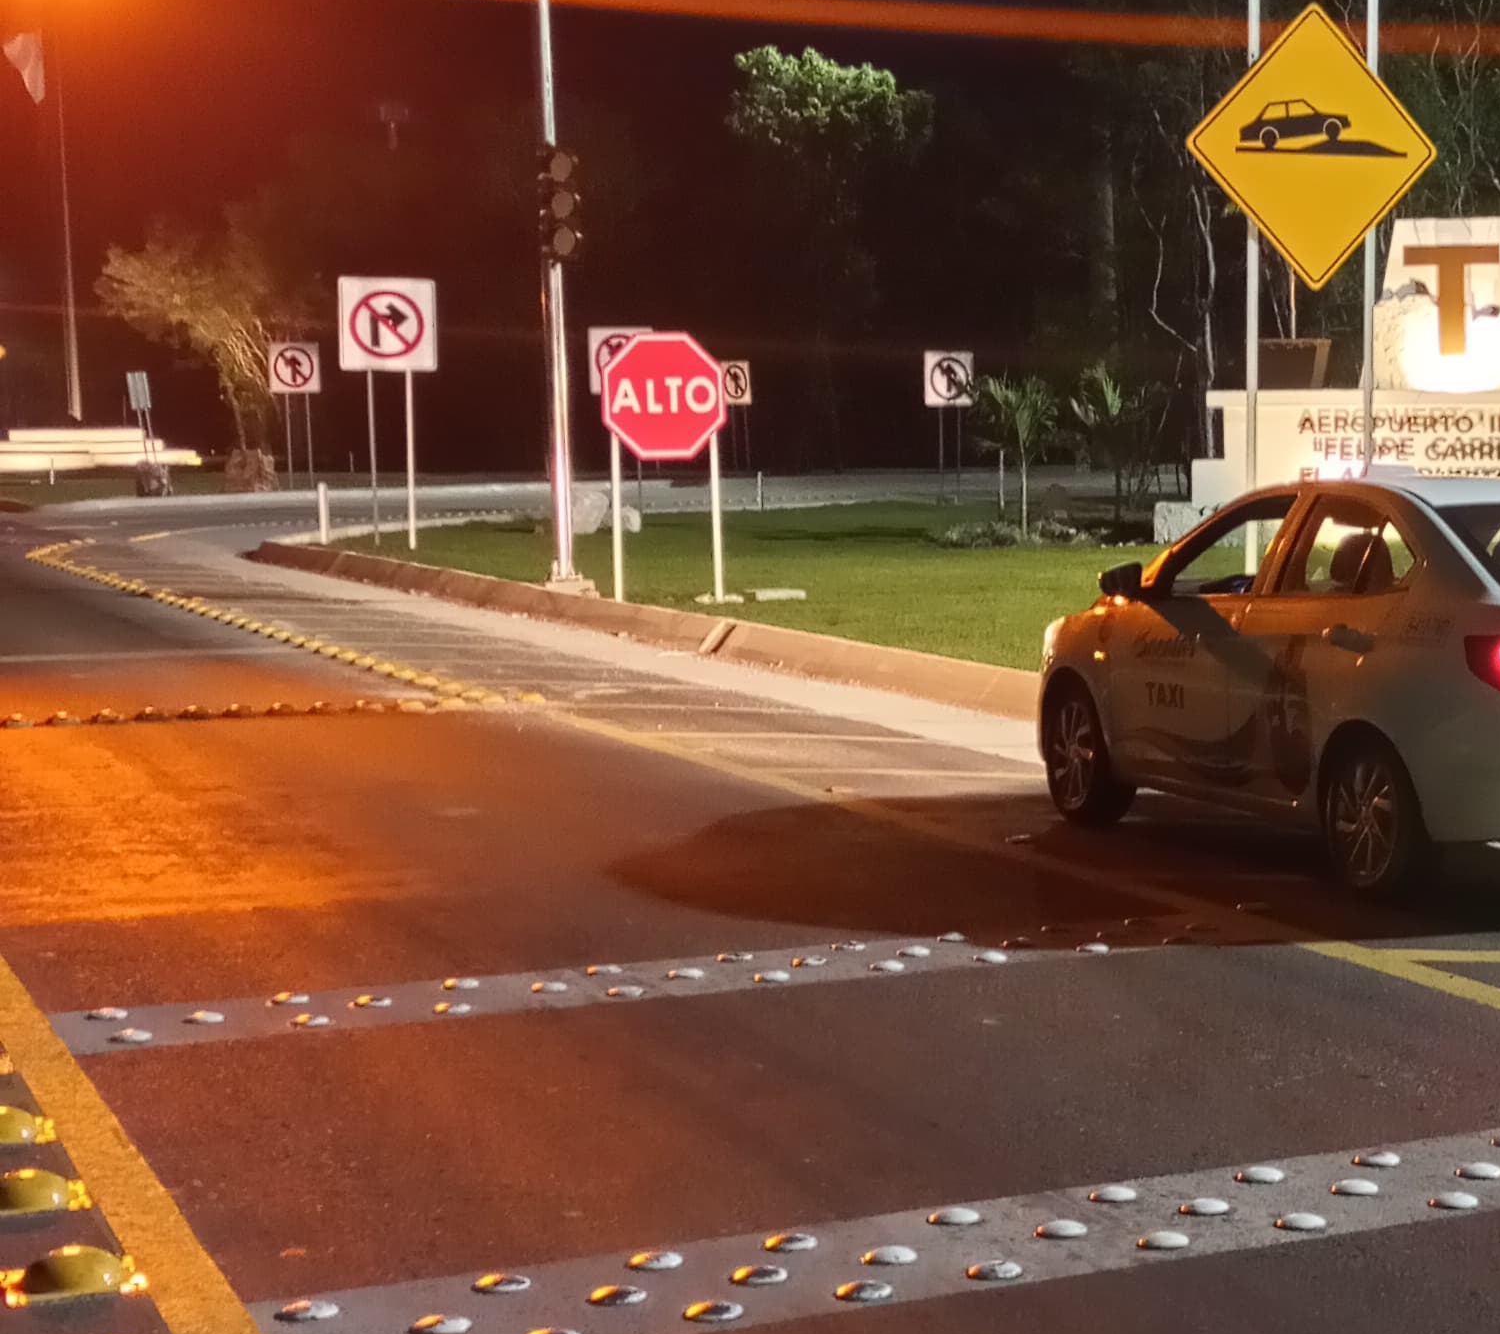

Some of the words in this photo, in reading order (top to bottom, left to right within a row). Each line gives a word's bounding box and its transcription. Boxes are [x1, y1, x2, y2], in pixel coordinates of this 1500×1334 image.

[611, 376, 717, 415] ALTO
[1298, 413, 1473, 434] AEROPUERTO
[1145, 681, 1185, 709] TAXI
